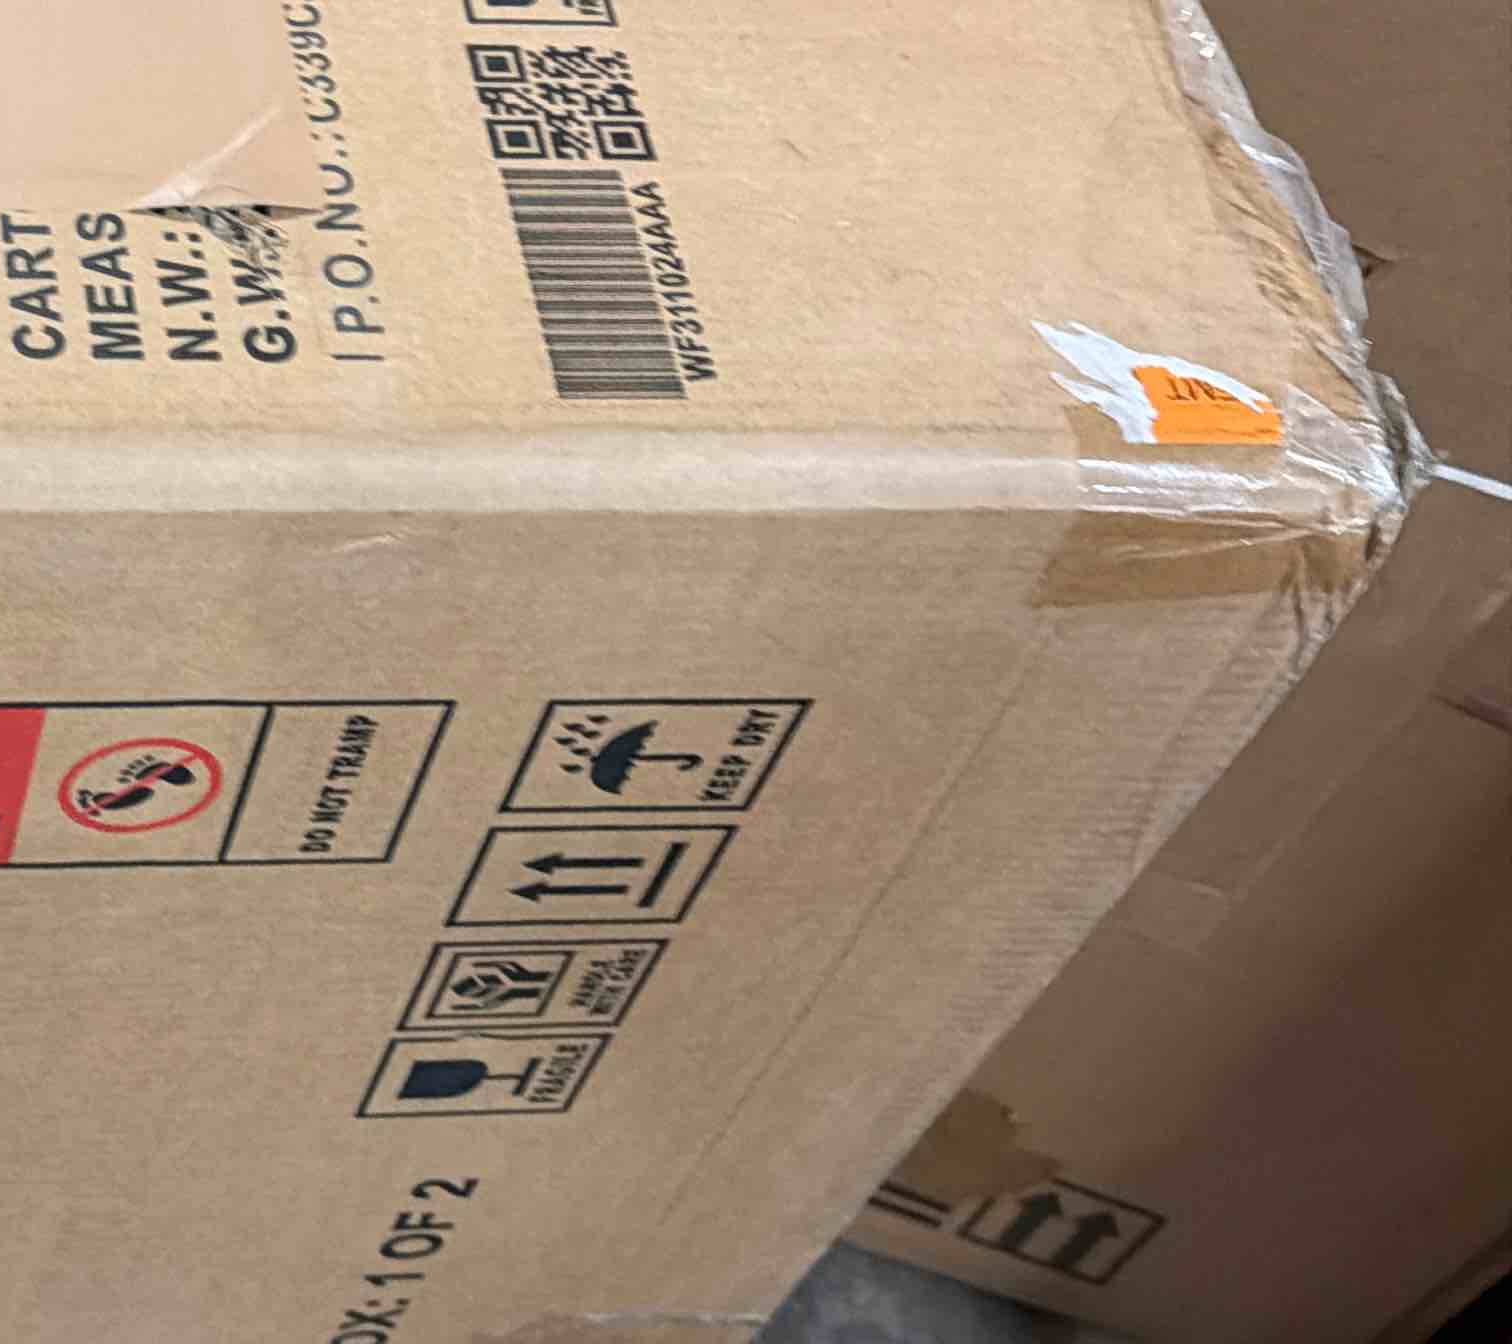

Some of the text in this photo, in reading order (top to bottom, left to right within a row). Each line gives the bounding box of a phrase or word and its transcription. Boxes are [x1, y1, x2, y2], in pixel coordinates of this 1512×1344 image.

[630, 181, 719, 382] WF311024AAA
[299, 715, 380, 852] DO NOT TRAMP
[697, 708, 781, 801] KEEP DRY
[410, 1176, 481, 1199] 2
[378, 1211, 455, 1261] OF
[363, 1270, 426, 1285] 1
